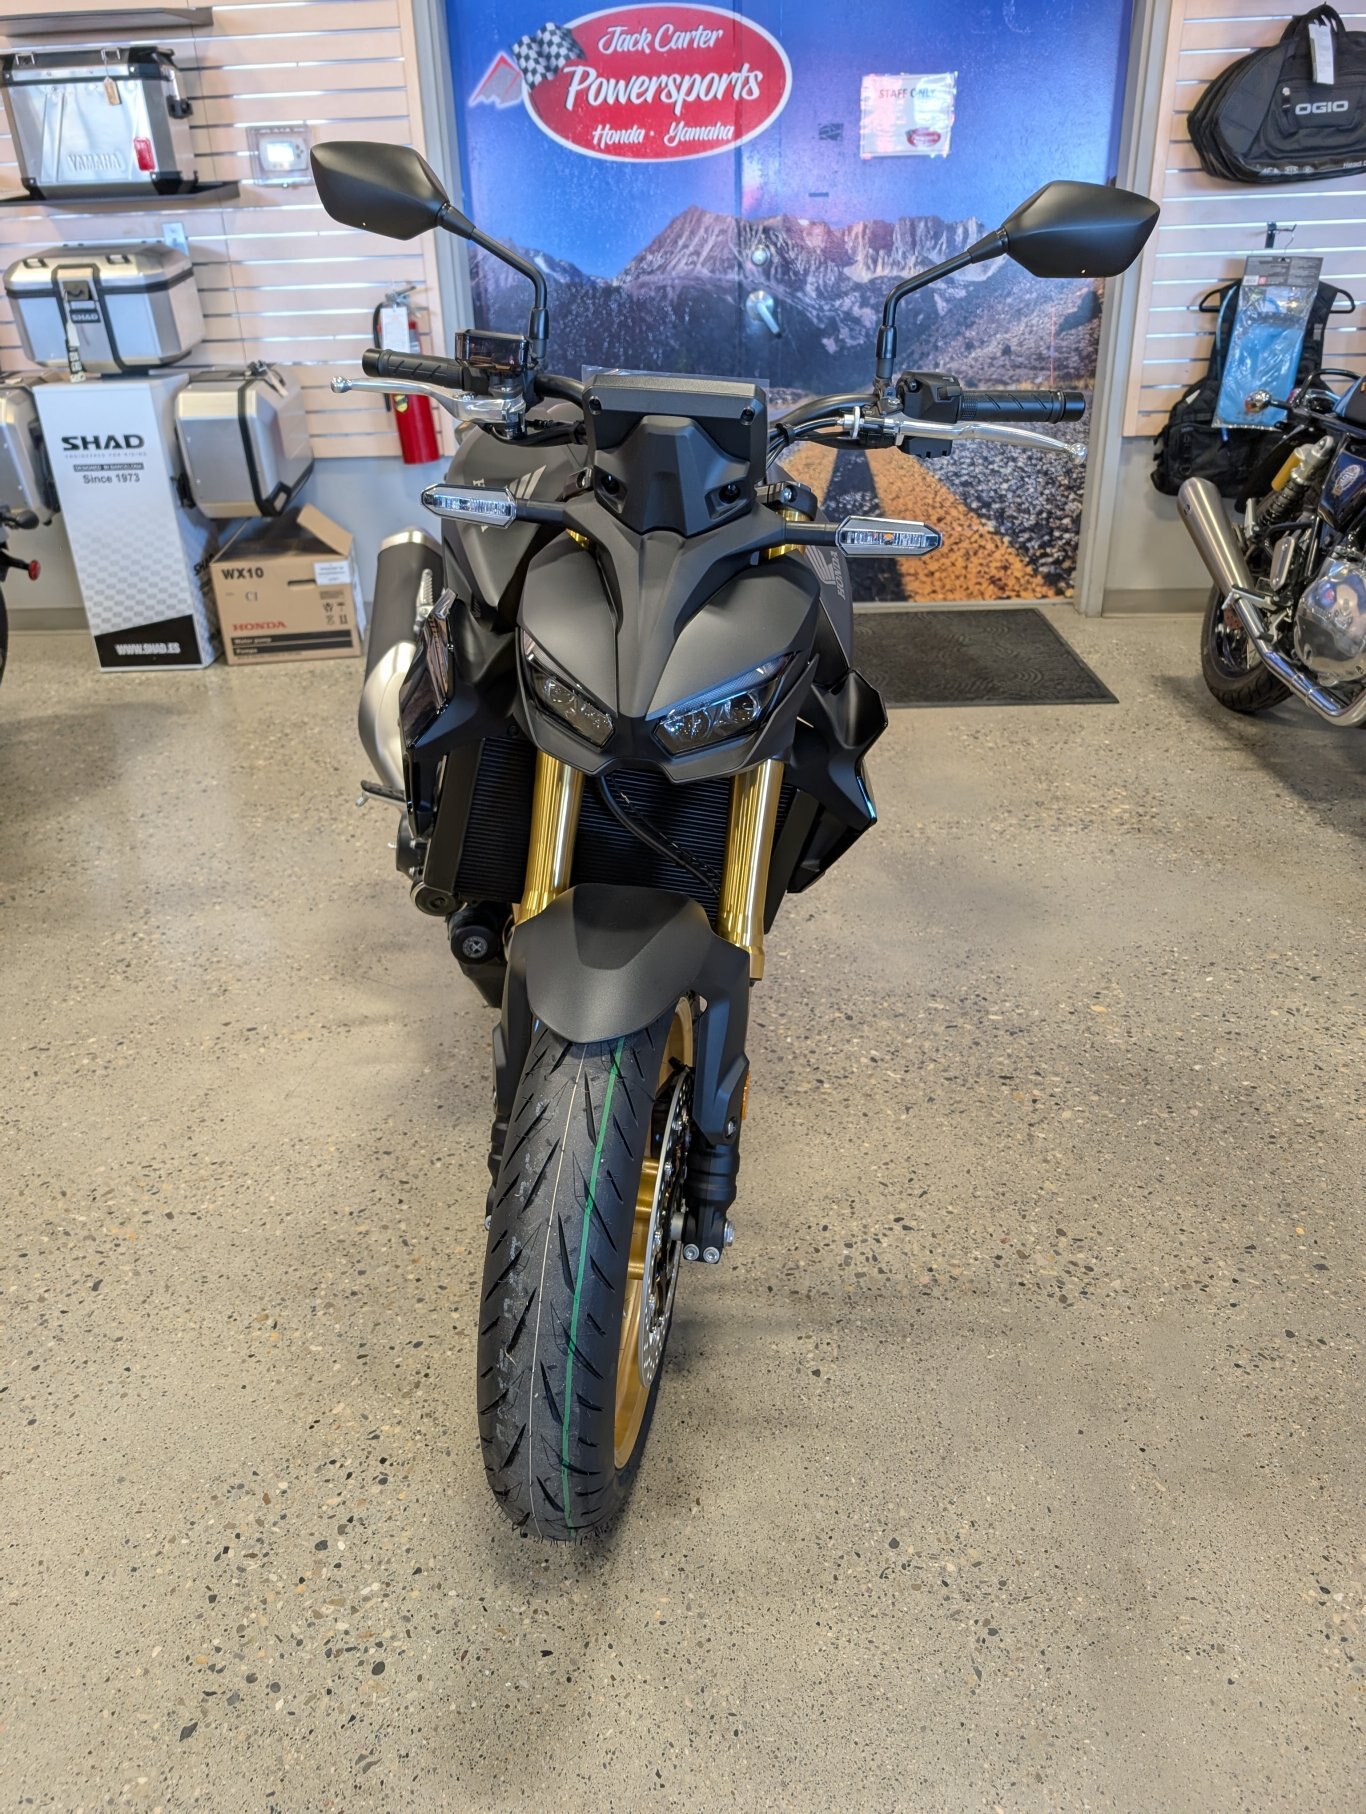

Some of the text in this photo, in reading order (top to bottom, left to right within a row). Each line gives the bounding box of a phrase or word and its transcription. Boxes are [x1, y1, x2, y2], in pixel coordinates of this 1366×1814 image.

[598, 24, 723, 54] Jack Carter
[564, 62, 763, 117] Powersports
[879, 89, 907, 99] STAFF
[1295, 100, 1349, 115] OGIO
[592, 121, 735, 149] Honda Yamaha
[67, 152, 122, 171] YAMAHA
[61, 434, 145, 451] SHAD
[83, 473, 140, 484] Since 1973
[221, 567, 265, 580] WX10
[830, 550, 846, 600] HONDA
[232, 620, 287, 632] HONDA
